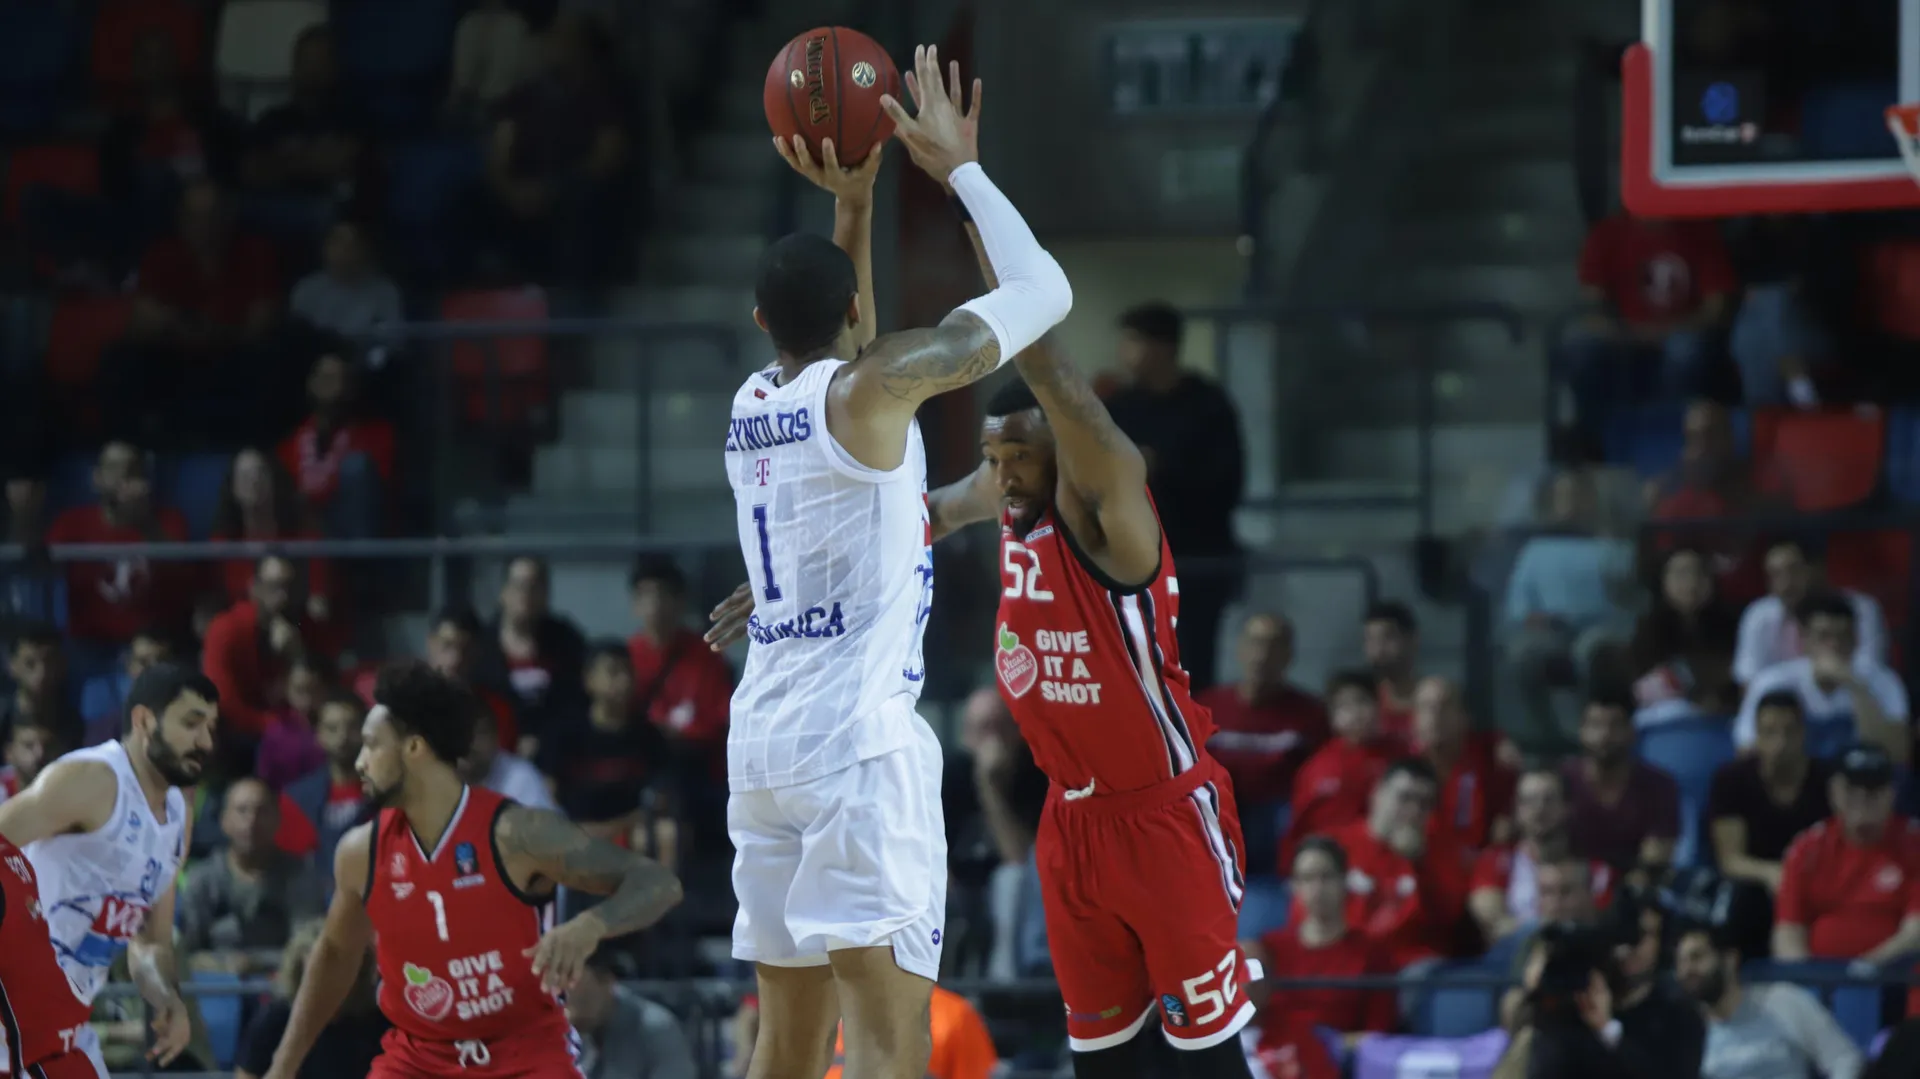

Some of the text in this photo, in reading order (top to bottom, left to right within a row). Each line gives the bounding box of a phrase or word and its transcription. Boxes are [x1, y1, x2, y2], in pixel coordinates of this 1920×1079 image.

[726, 407, 811, 452] EYNOLDS
[752, 503, 783, 603] 1
[1004, 540, 1054, 601] 52
[1036, 629, 1091, 653] GIVE
[1044, 655, 1092, 679] IT A
[1040, 680, 1101, 704] SHOT
[427, 890, 449, 941] 1
[448, 950, 503, 978] GIVE
[458, 977, 480, 998] IT
[487, 973, 505, 993] A
[1182, 949, 1238, 1025] 52
[456, 988, 515, 1021] SHOT
